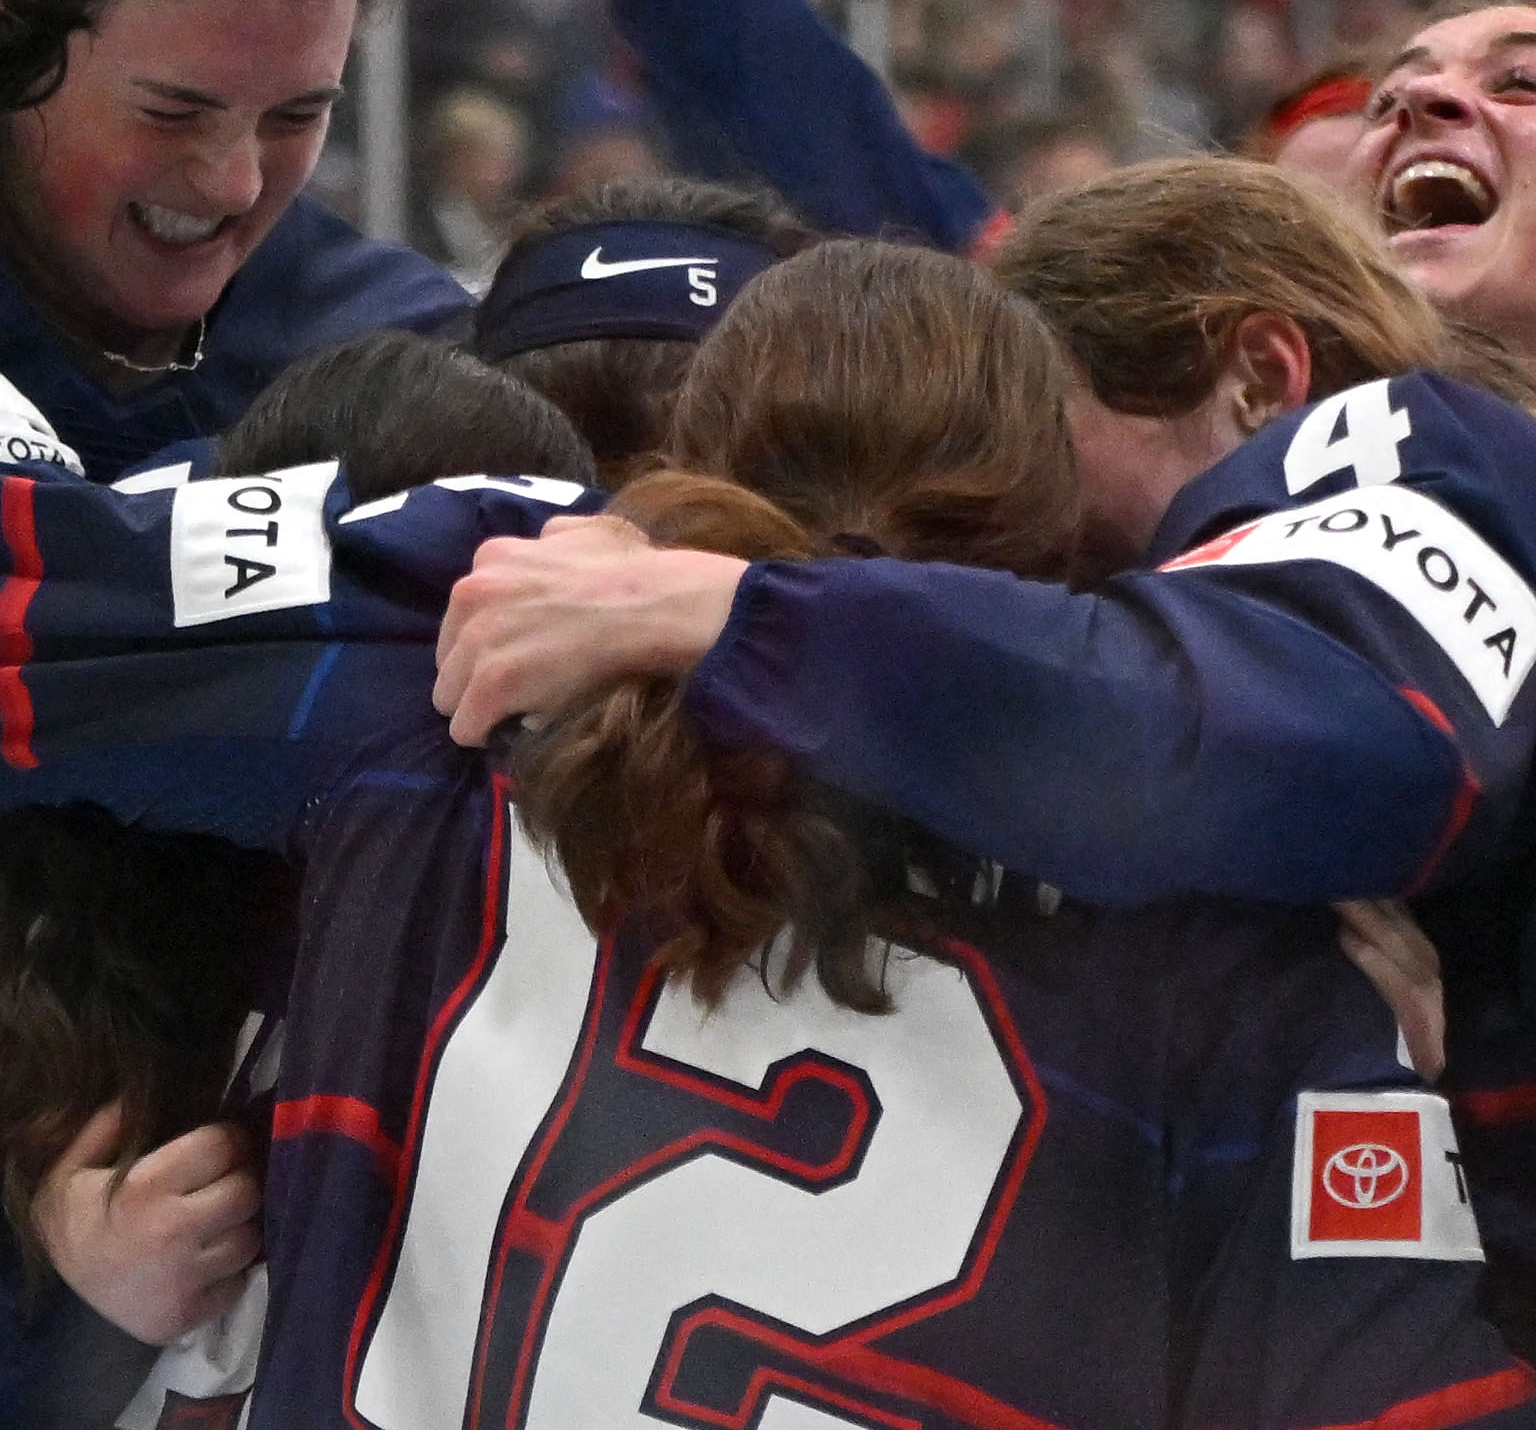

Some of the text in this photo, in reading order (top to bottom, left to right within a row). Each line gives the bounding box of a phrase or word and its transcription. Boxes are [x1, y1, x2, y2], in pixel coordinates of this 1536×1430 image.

[688, 266, 718, 307] 5
[1283, 377, 1412, 496] 4
[224, 476, 283, 599] OTA
[1283, 507, 1518, 679] TOYOTA
